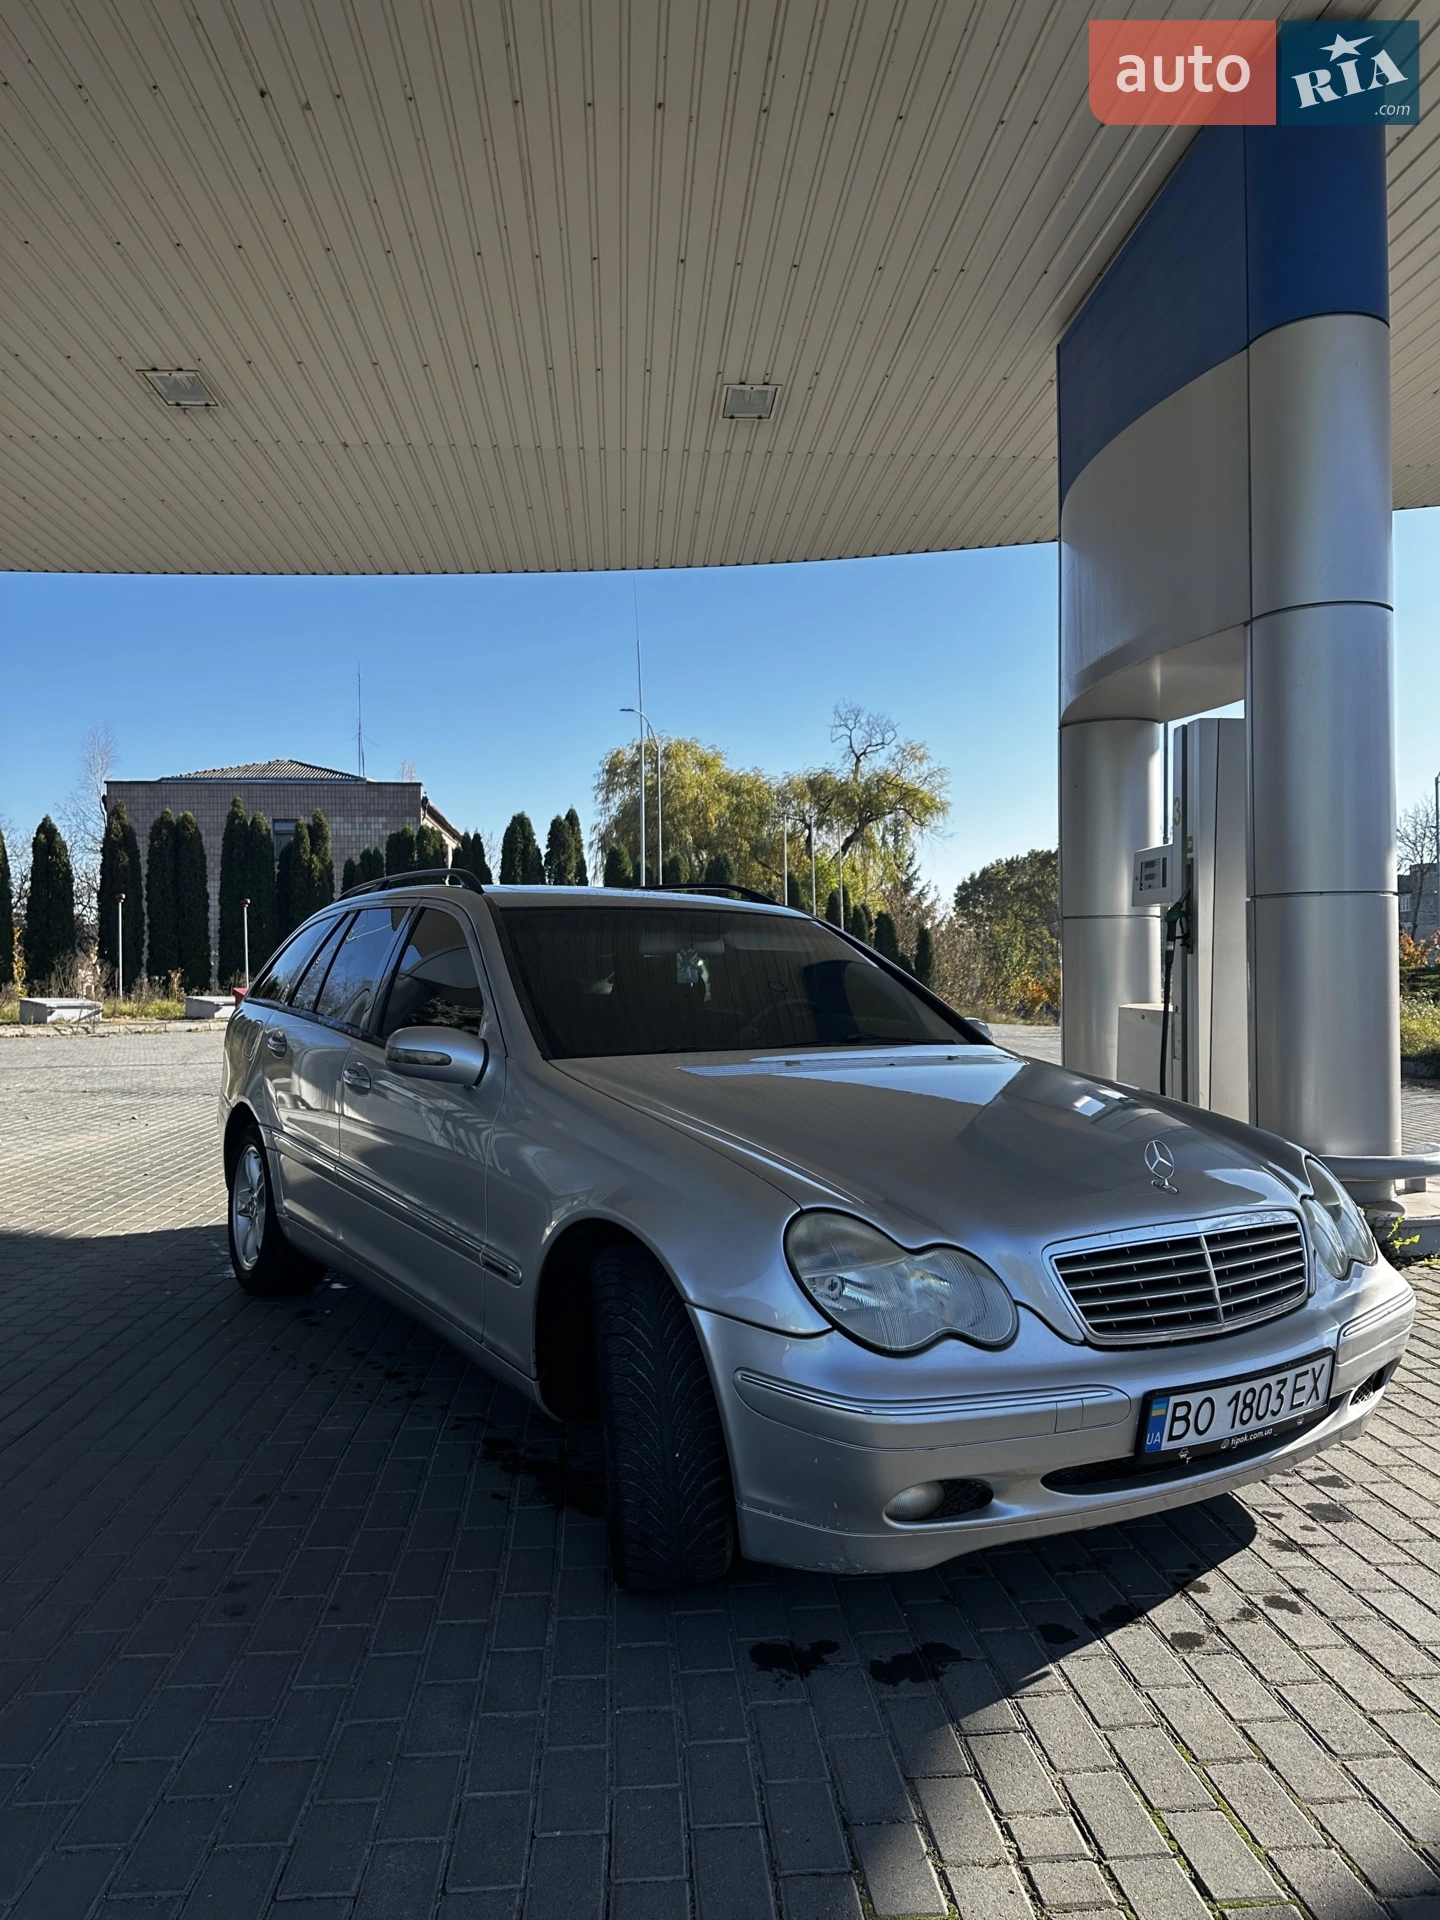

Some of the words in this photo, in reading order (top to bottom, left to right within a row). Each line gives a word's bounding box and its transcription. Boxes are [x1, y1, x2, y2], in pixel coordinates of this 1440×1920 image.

[1173, 796, 1181, 826] 3
[1167, 1397, 1216, 1442] BO
[1227, 1377, 1288, 1430] 1803
[1289, 1363, 1326, 1411] EX
[1146, 1431, 1161, 1445] UA
